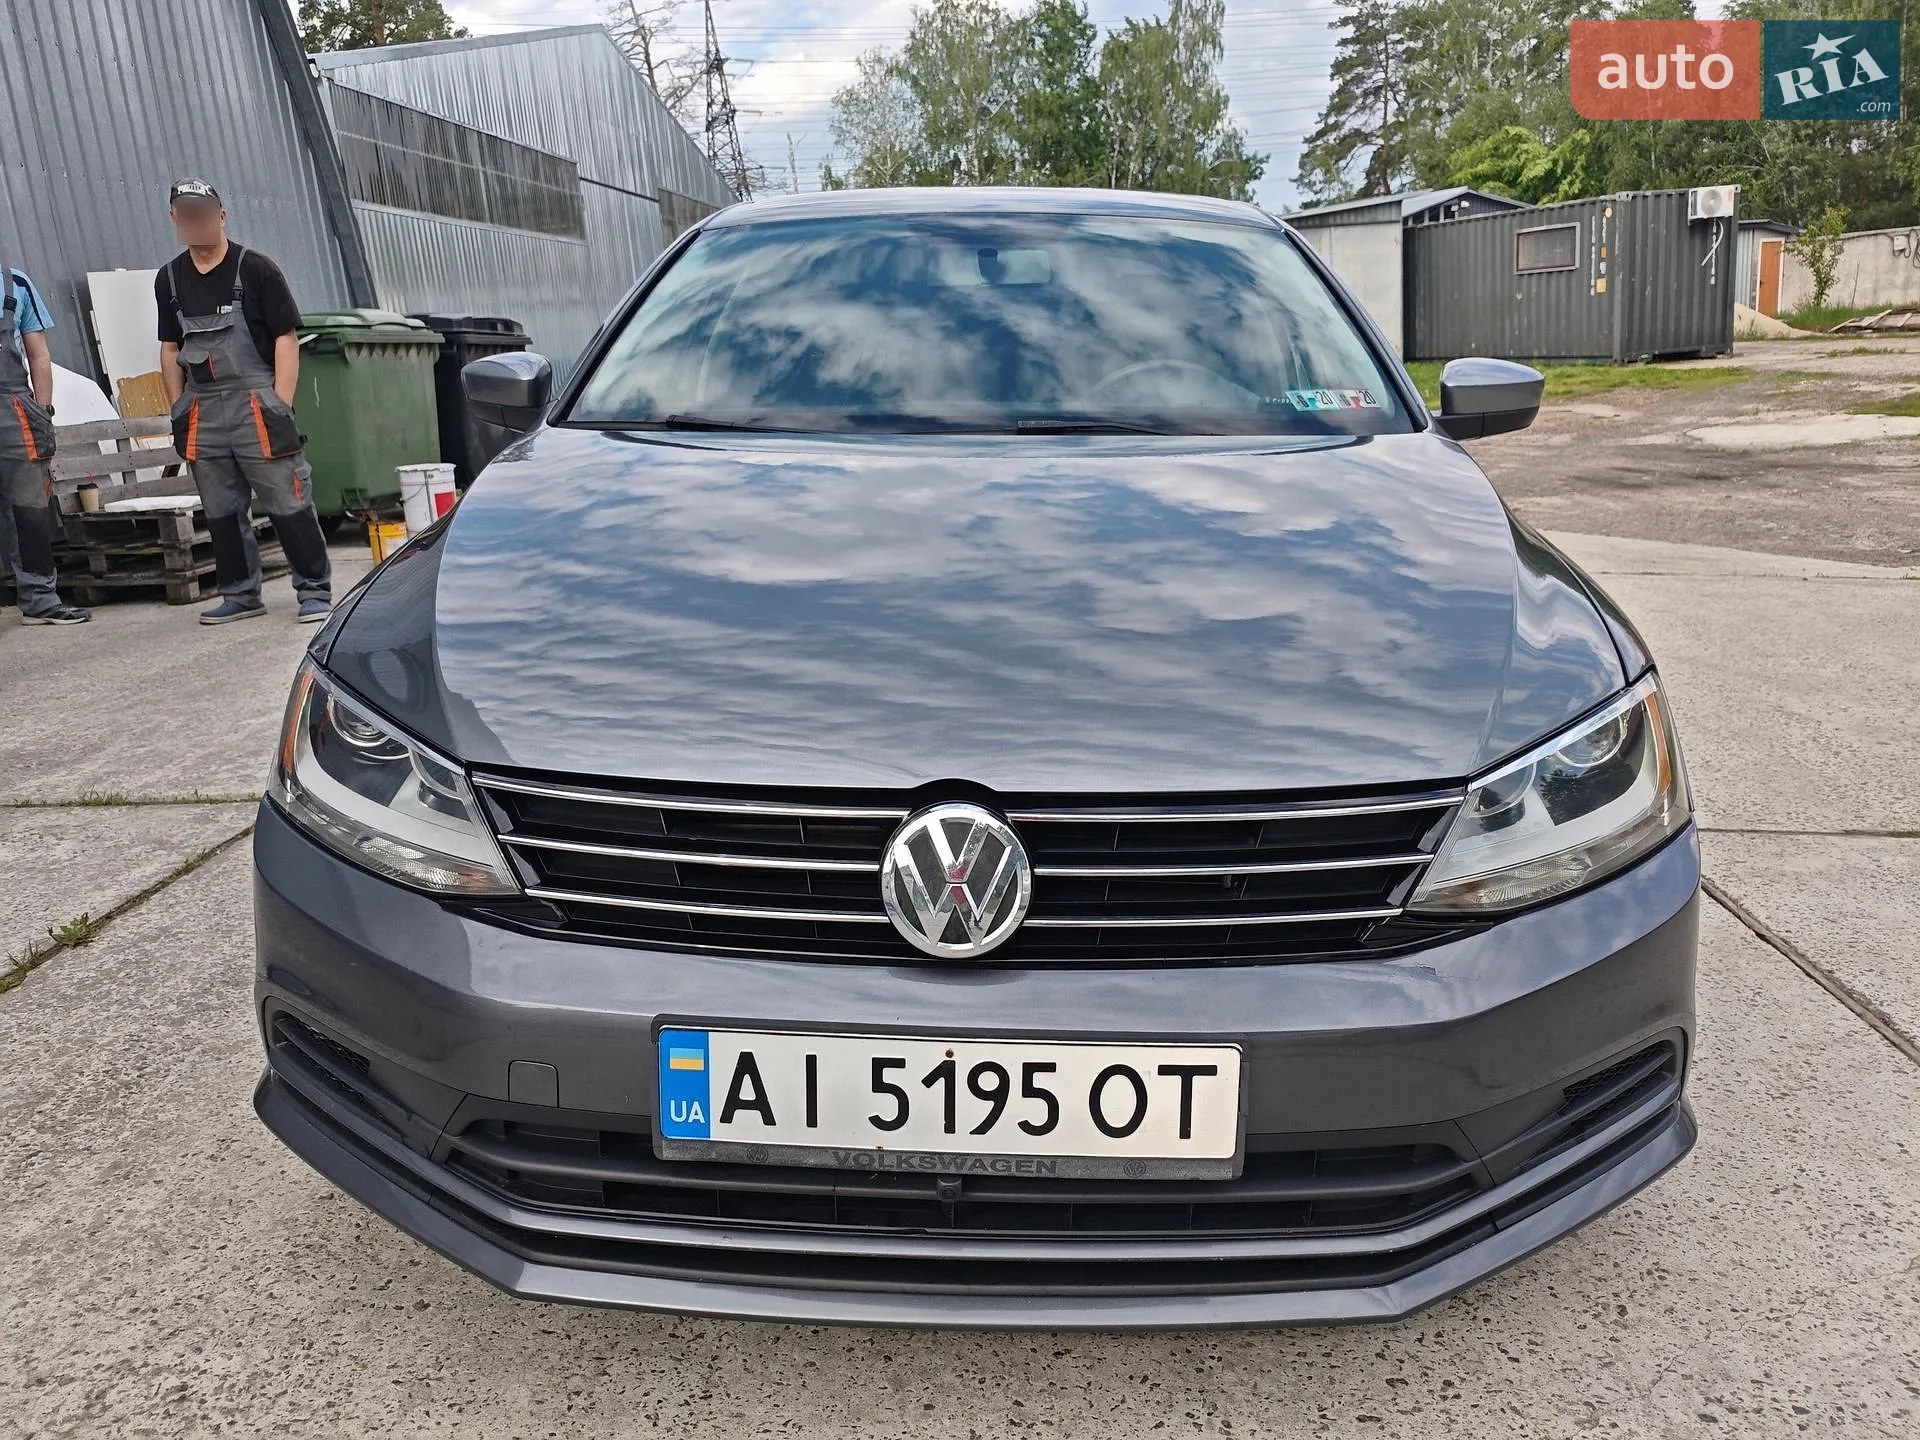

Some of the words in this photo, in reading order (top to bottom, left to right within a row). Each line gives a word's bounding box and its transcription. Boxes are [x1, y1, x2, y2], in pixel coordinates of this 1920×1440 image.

[718, 1051, 818, 1128] AI
[868, 1056, 1060, 1136] 5195
[1088, 1063, 1218, 1140] OT
[669, 1099, 706, 1124] UA
[832, 1149, 1058, 1175] VOLKSWAGEN
